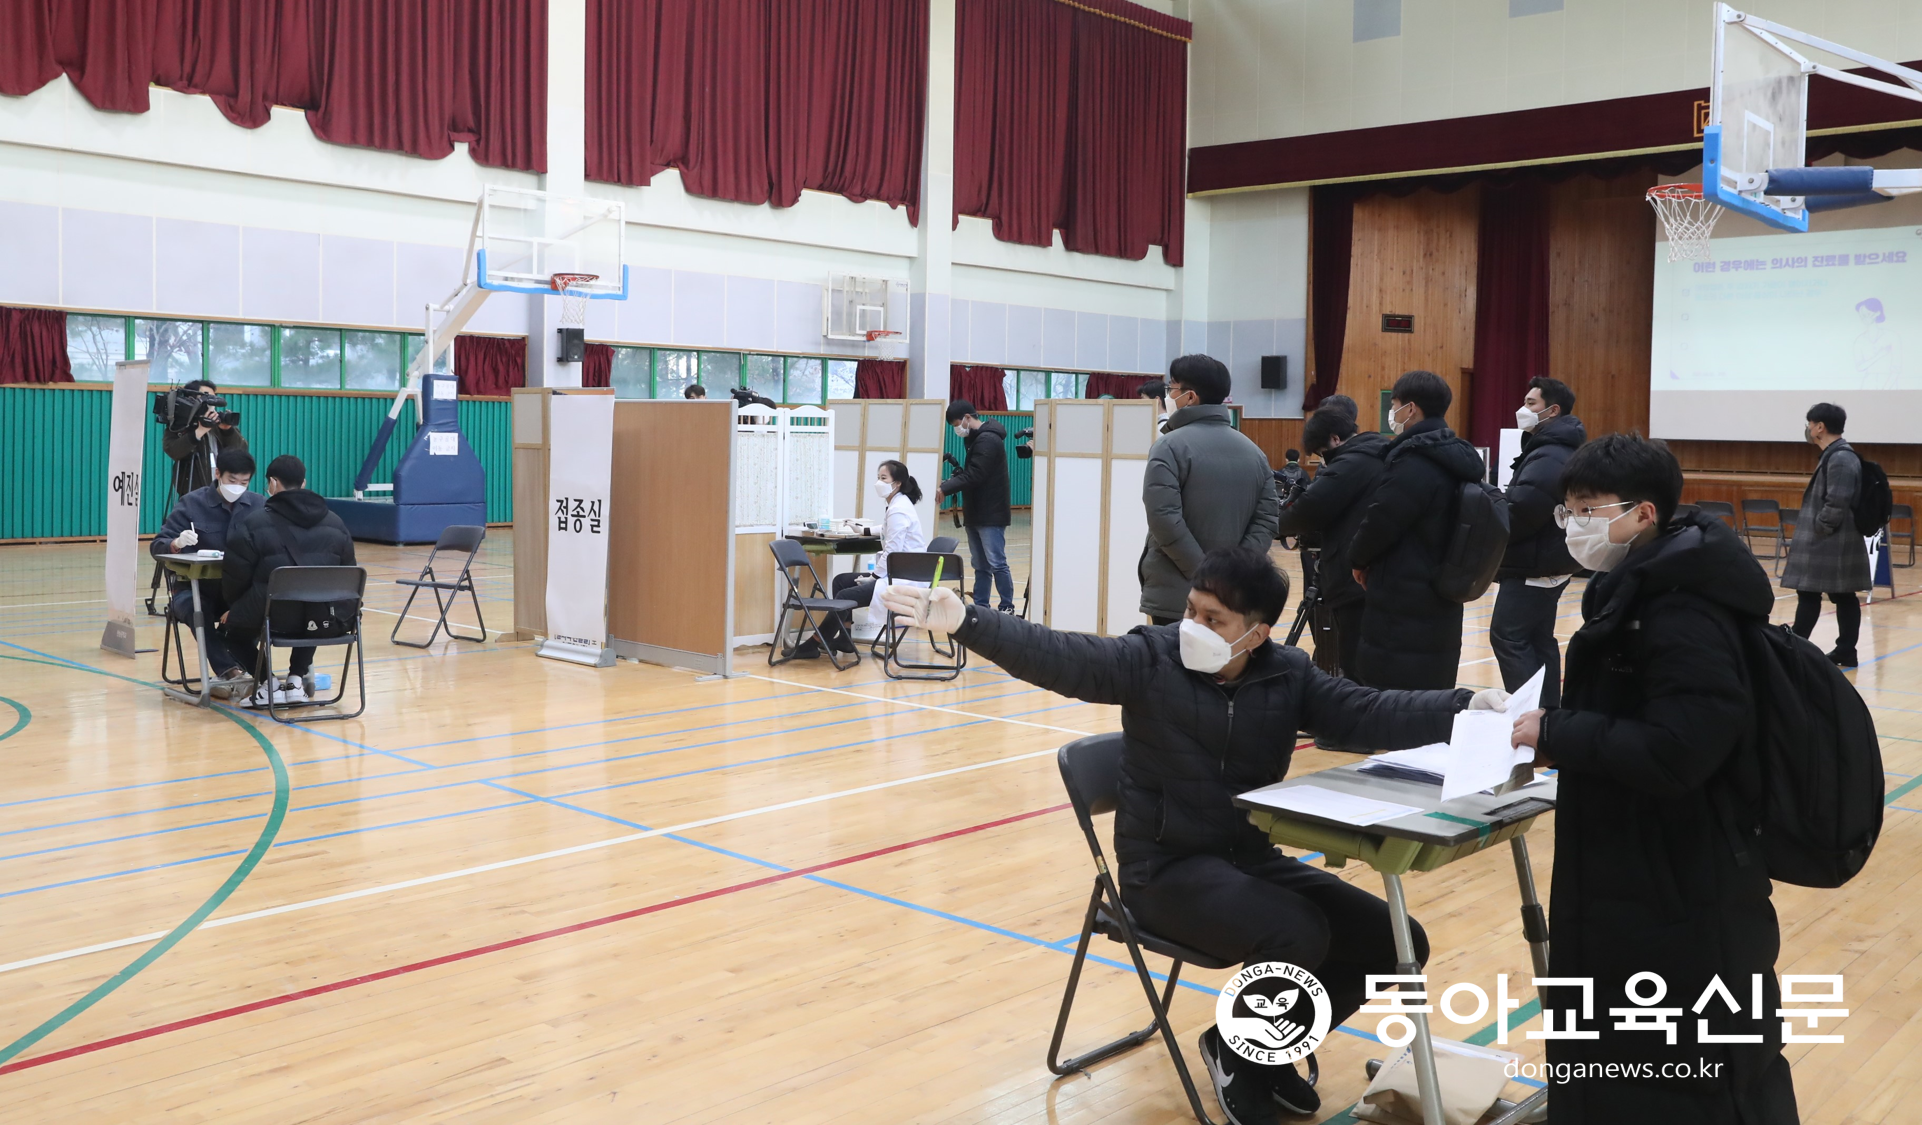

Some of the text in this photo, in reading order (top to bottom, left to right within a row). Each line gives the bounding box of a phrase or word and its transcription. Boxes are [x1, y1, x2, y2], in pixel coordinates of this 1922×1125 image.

[1693, 250, 1907, 273] 이런 경우에는 의사의 진료를 받으세요
[555, 497, 602, 534] 접종실
